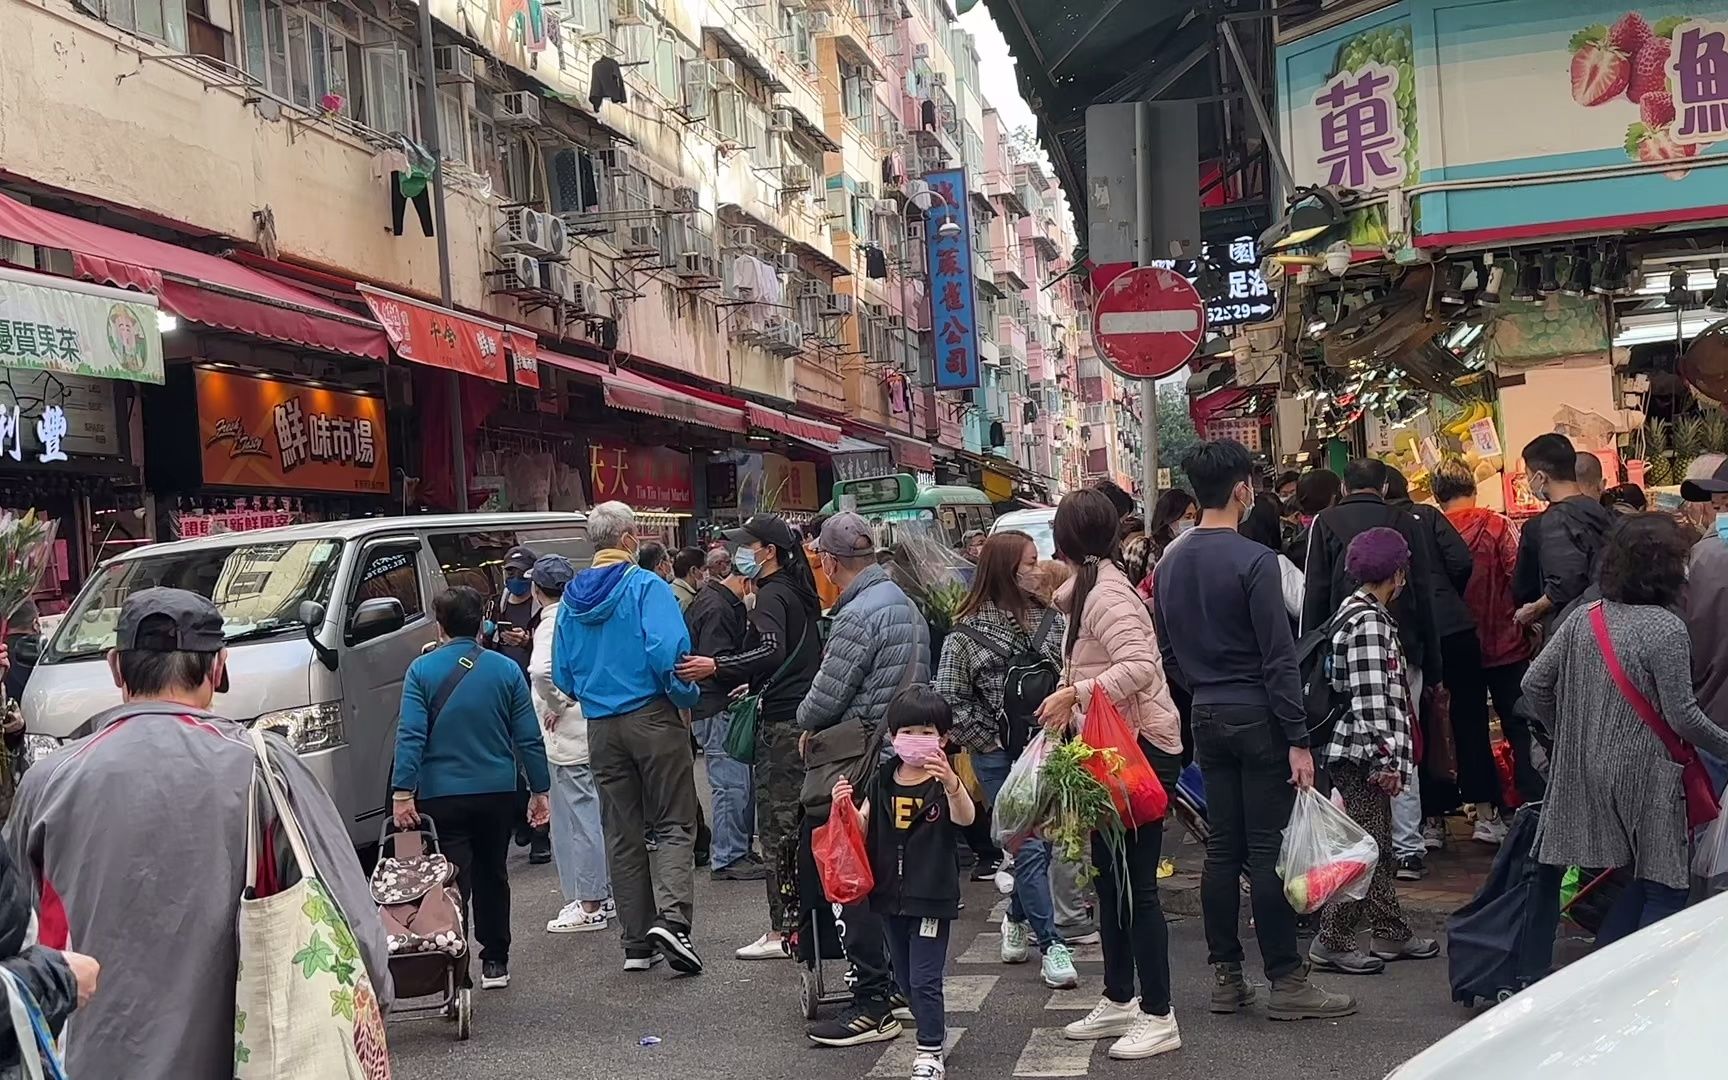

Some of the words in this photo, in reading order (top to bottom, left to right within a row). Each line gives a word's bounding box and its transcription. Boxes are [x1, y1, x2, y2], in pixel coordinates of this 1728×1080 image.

[1315, 71, 1397, 187] 菓
[274, 397, 374, 470] 鮮味市場
[590, 443, 628, 495] 天天
[671, 487, 690, 502] Market
